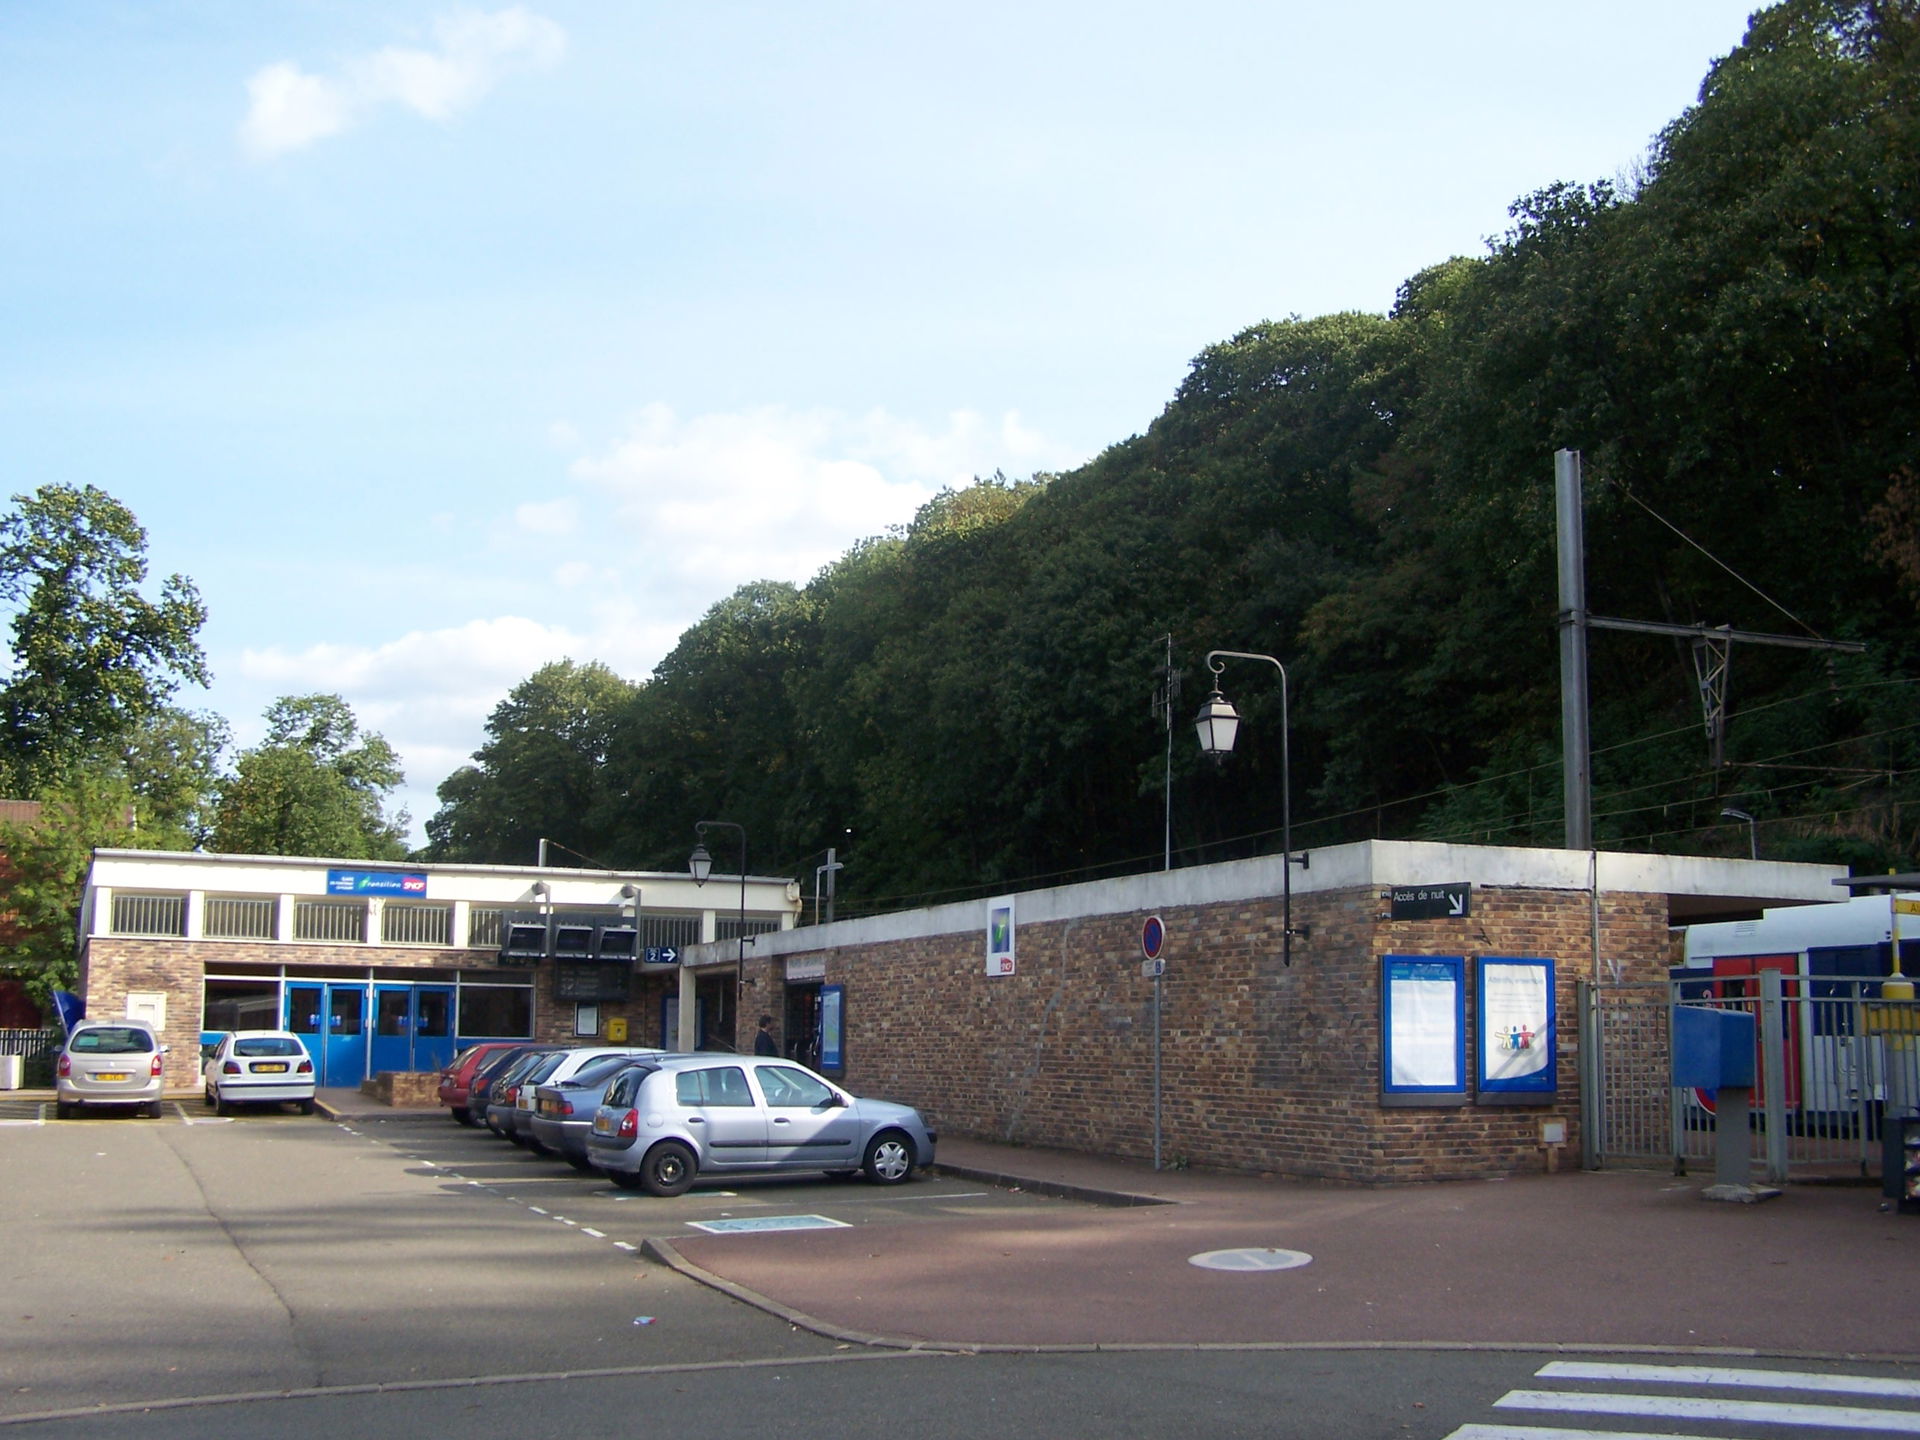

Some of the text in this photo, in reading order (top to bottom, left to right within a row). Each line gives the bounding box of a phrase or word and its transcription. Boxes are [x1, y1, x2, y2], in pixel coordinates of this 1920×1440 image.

[403, 882, 425, 890] SNCF
[1393, 890, 1445, 902] Accès de nuit
[650, 953, 656, 961] 2
